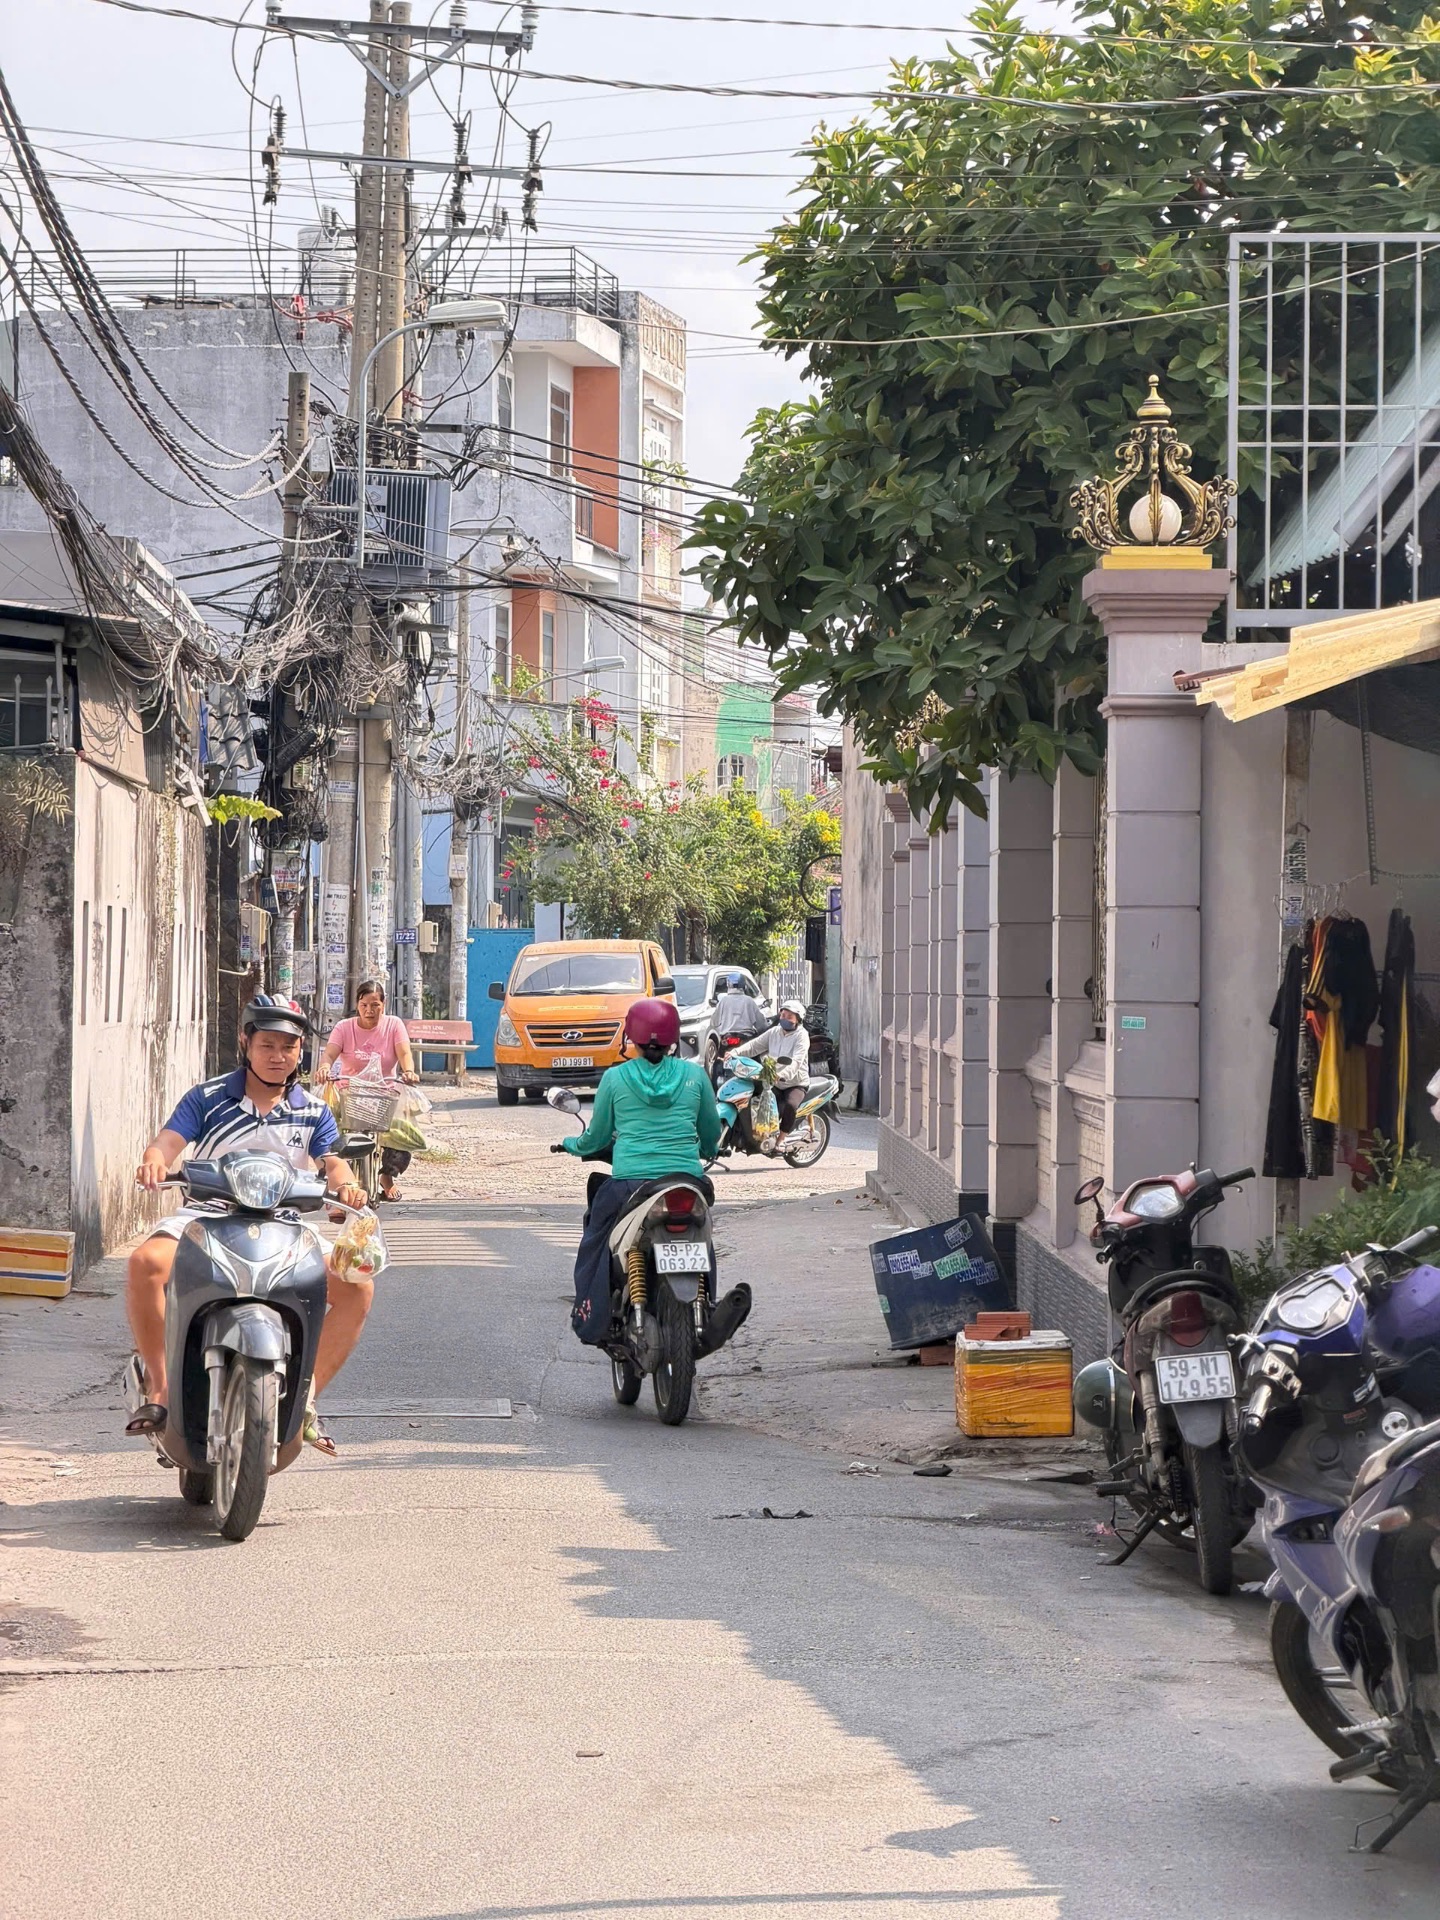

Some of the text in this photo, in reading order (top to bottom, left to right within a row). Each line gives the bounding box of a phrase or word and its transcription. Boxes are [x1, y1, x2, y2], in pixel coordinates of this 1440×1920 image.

[662, 1244, 701, 1257] 59-P2
[659, 1257, 707, 1271] 063.22
[1167, 1356, 1219, 1379] 59-N1
[1163, 1376, 1231, 1399] 149.55
